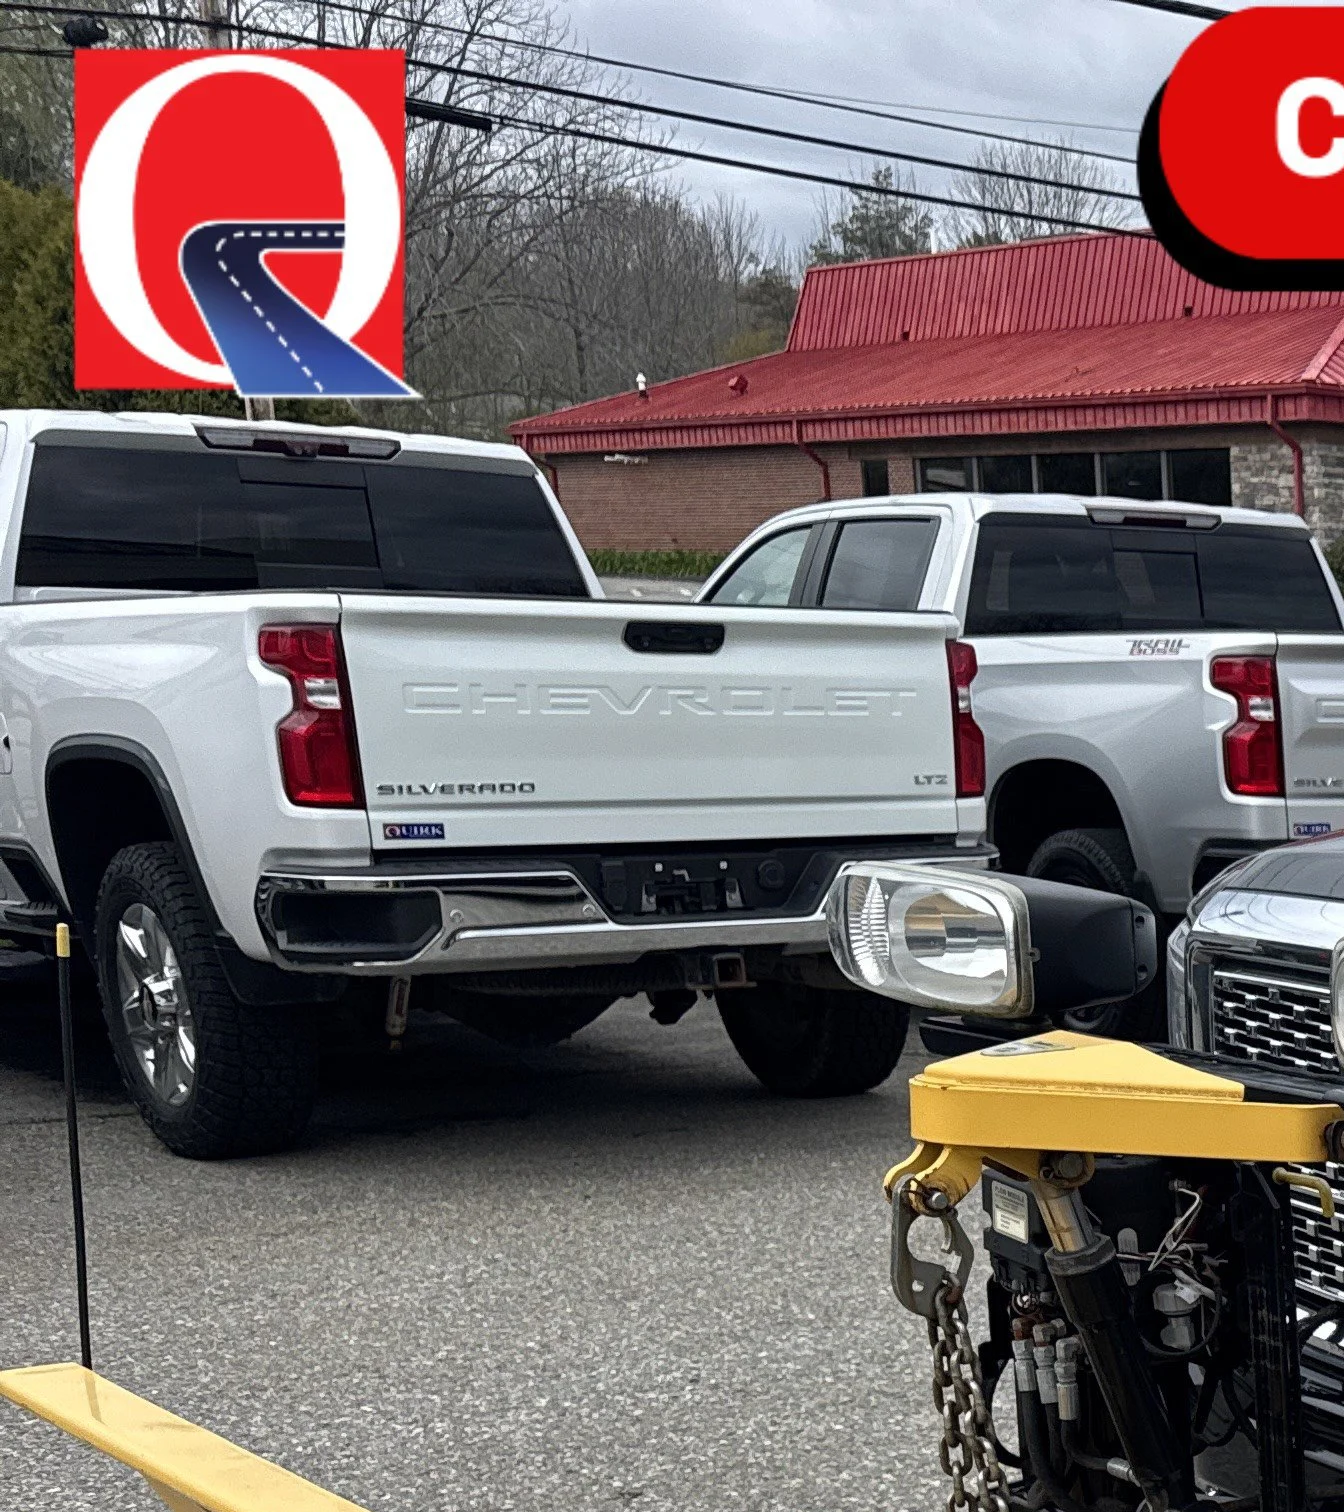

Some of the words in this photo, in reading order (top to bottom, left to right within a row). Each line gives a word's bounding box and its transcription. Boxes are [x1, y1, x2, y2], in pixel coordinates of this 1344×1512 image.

[402, 682, 917, 716] CHEVROLET
[914, 774, 948, 785] LTZ
[376, 782, 536, 796] SILVERADO
